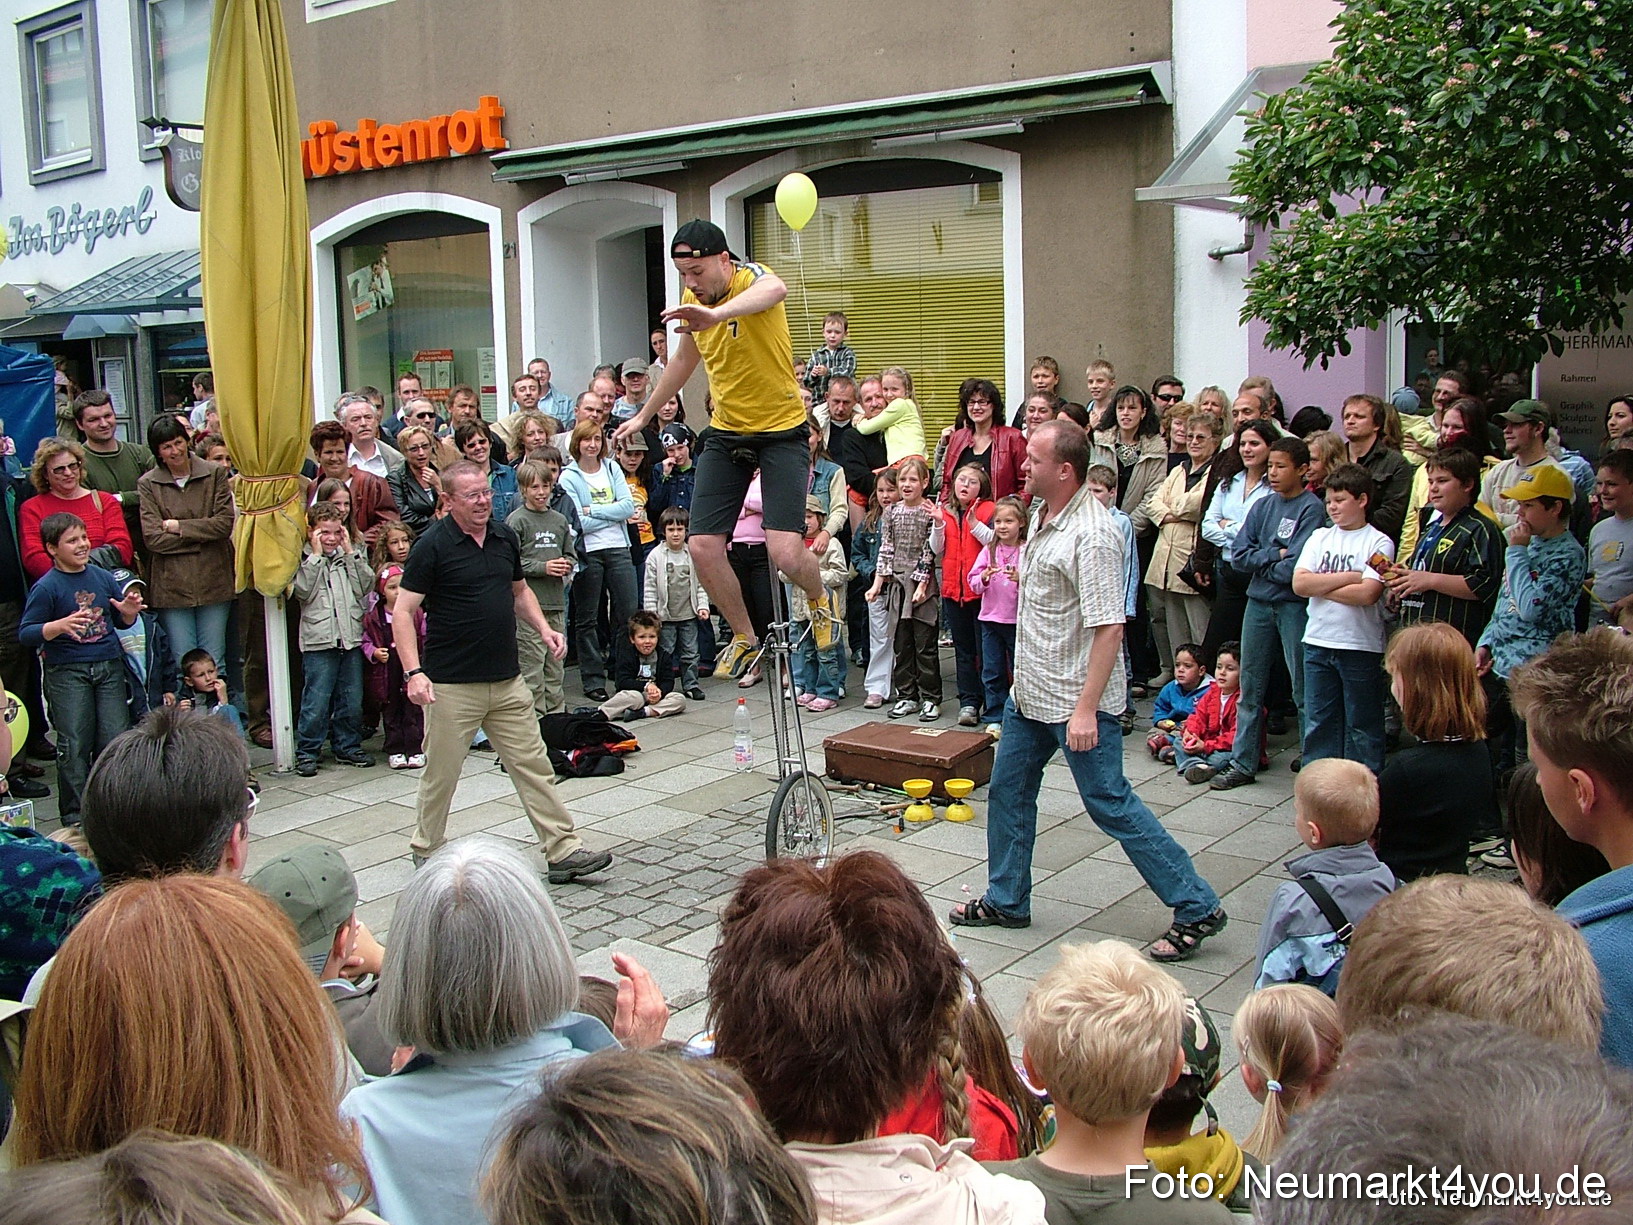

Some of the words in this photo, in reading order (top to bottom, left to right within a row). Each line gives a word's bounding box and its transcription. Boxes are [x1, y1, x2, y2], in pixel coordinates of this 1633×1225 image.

[48, 185, 154, 255] Bögerl
[503, 242, 517, 259] 21
[727, 319, 738, 338] 7
[1560, 373, 1597, 383] Rahmen
[1560, 401, 1595, 412] Graphik
[1560, 413, 1597, 424] Skulptur
